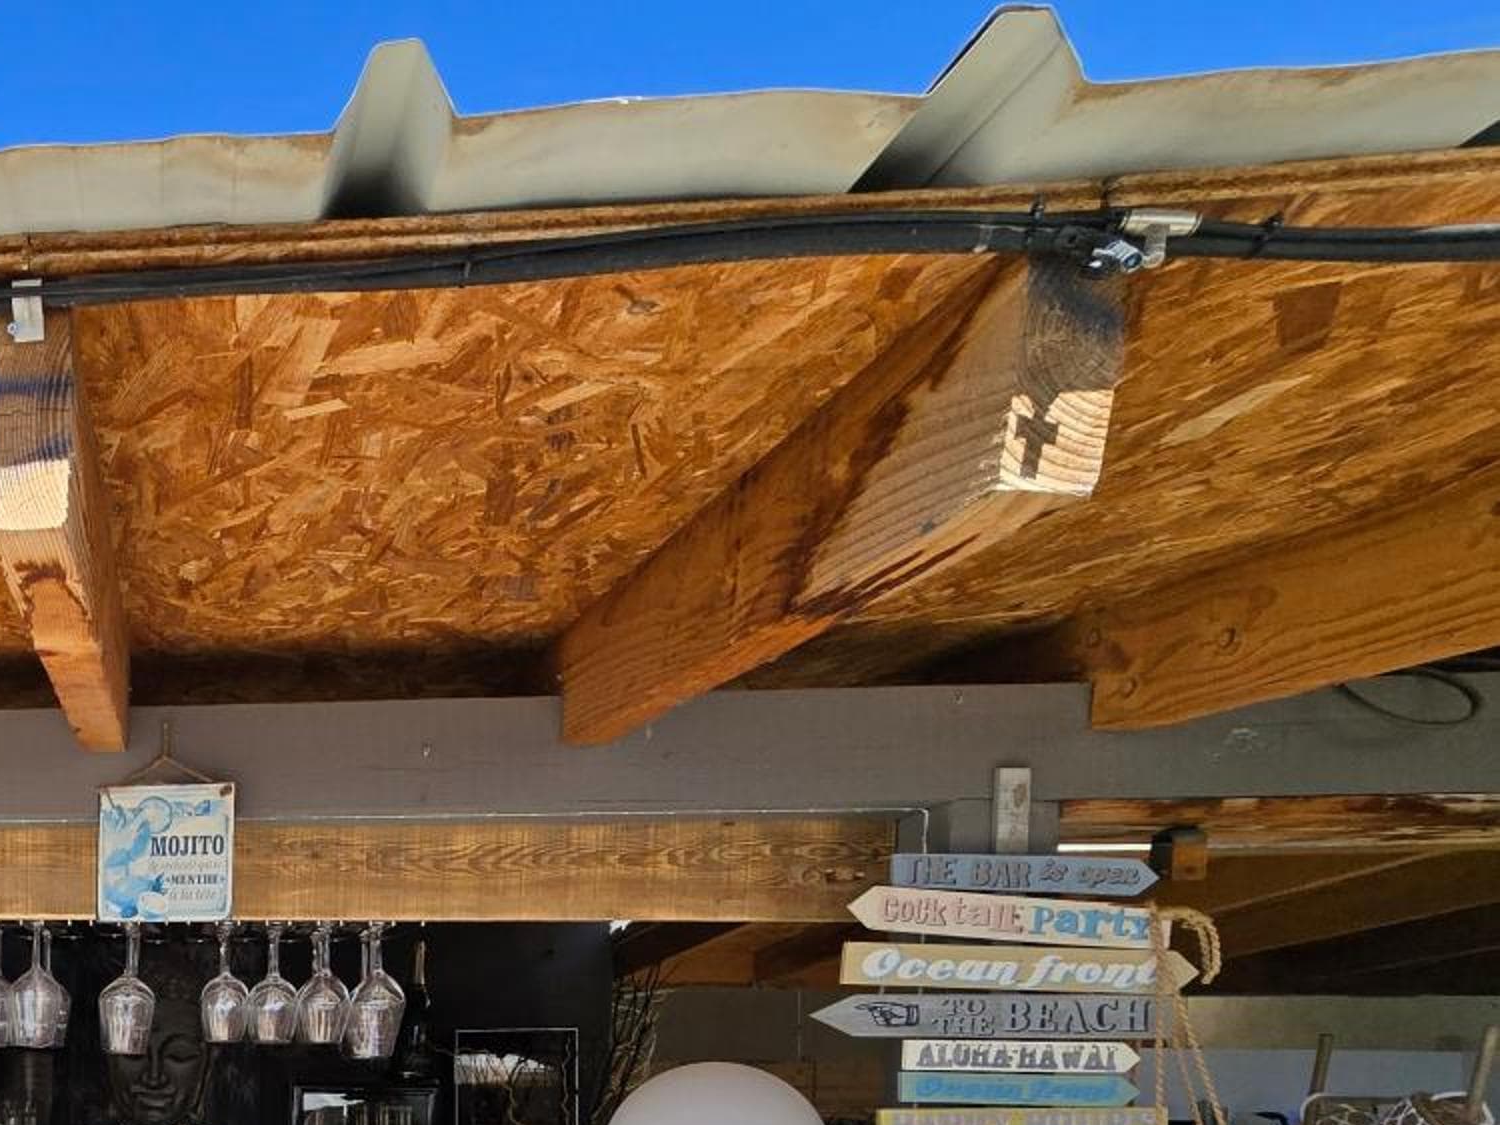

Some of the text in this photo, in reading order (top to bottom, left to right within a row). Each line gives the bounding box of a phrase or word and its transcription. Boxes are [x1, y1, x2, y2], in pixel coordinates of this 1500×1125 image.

[150, 835, 225, 857] MOJITO
[907, 856, 1142, 888] THE BAR is open
[861, 947, 1157, 988] Ocean front
[931, 998, 1153, 1037] TO THE BEACH
